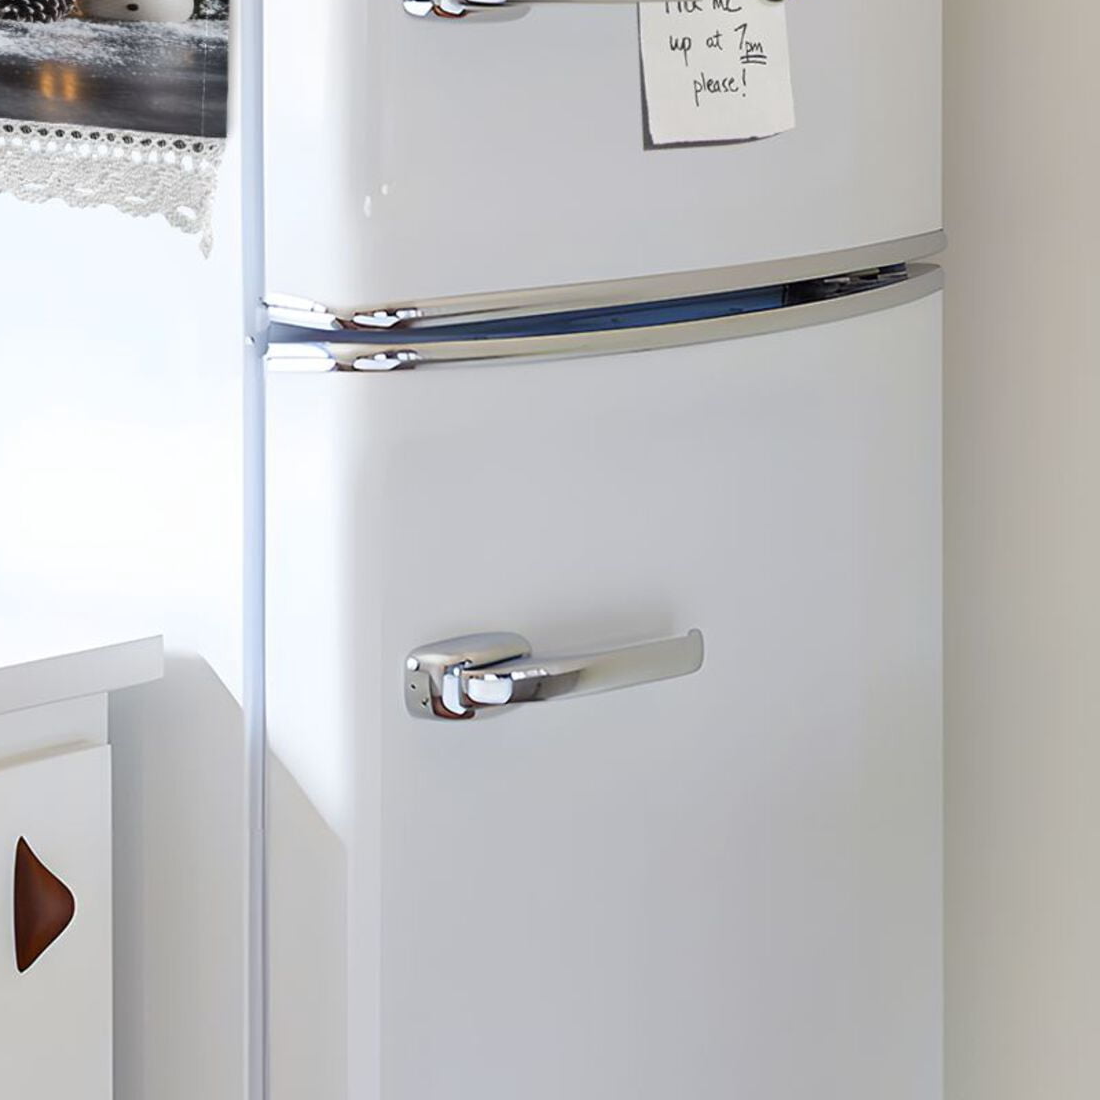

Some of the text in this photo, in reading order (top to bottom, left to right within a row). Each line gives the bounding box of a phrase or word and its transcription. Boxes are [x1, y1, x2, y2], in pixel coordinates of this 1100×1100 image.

[669, 35, 692, 67] up
[706, 29, 723, 50] at
[693, 68, 747, 107] please!
